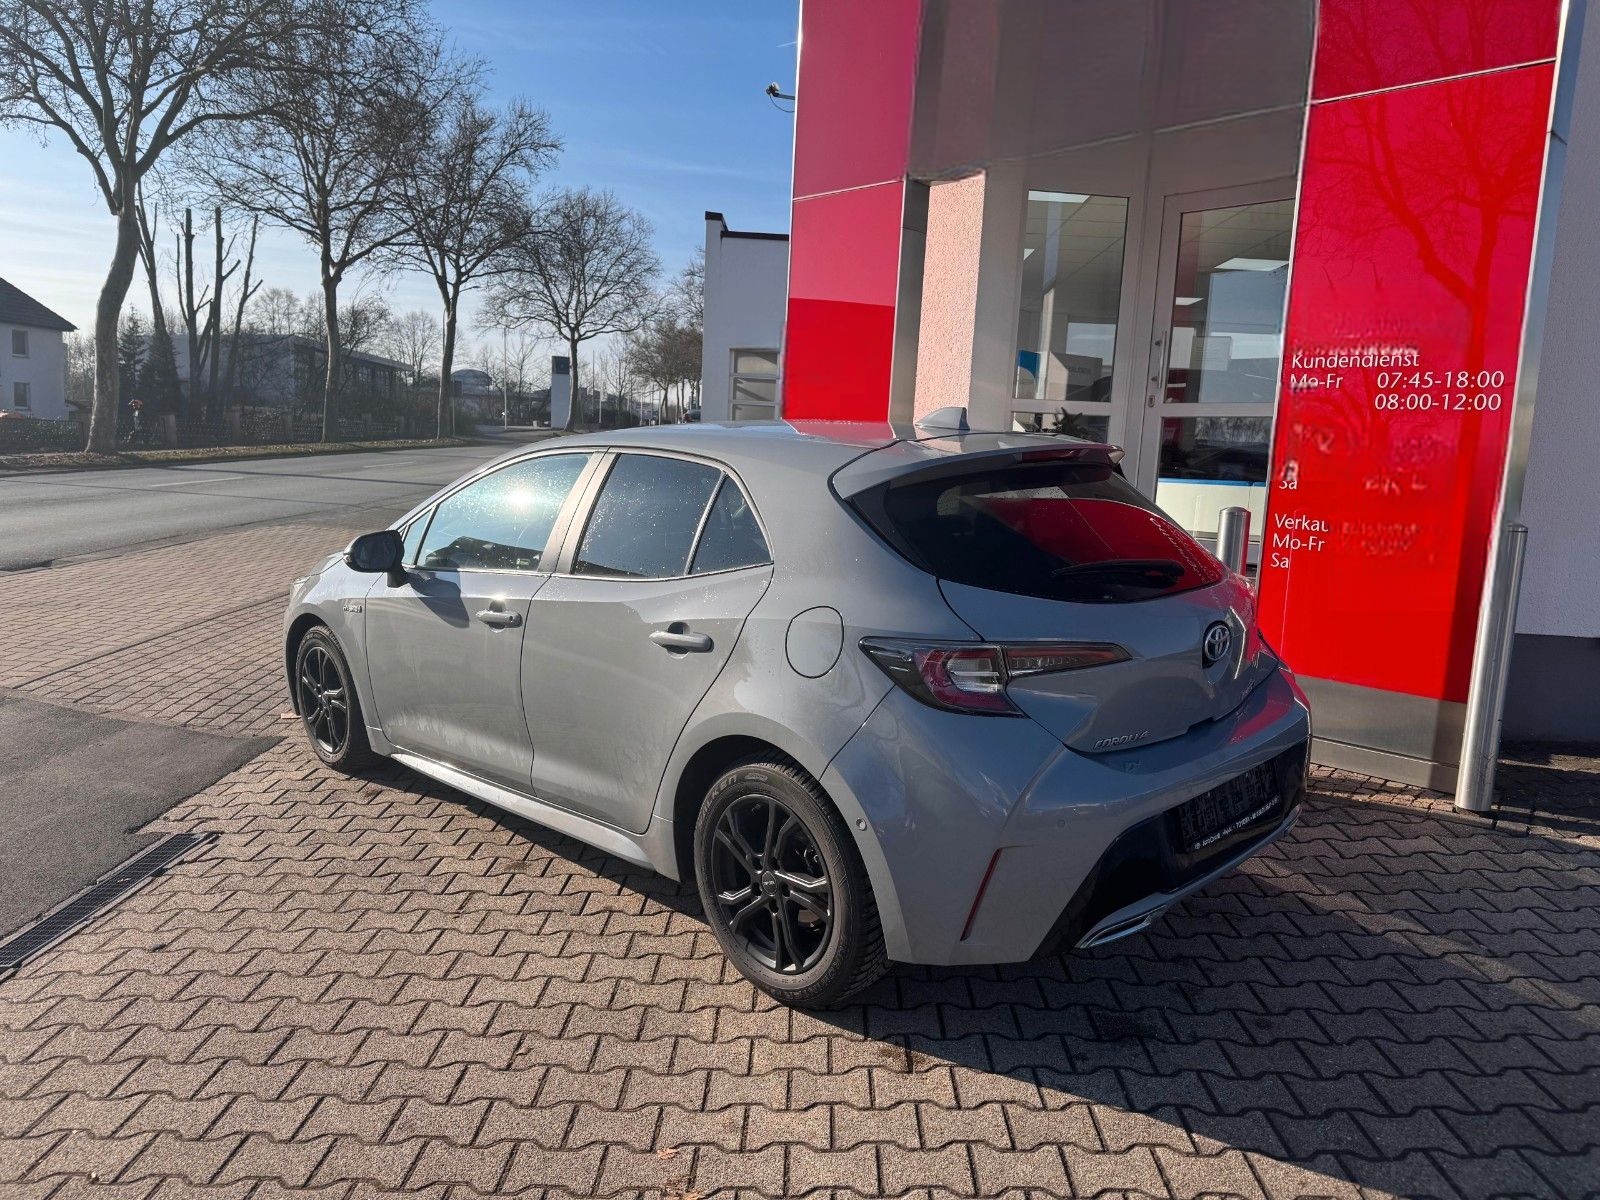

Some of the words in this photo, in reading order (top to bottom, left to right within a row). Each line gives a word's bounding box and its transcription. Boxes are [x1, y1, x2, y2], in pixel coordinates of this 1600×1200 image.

[1292, 354, 1420, 369] Kundendienst
[1290, 373, 1343, 389] Mo-Fr
[1377, 371, 1505, 389] 07:45-18:00
[1375, 393, 1502, 411] 08:00-12:00
[1272, 533, 1326, 552] Mo-Fr
[1270, 552, 1289, 569] Sa
